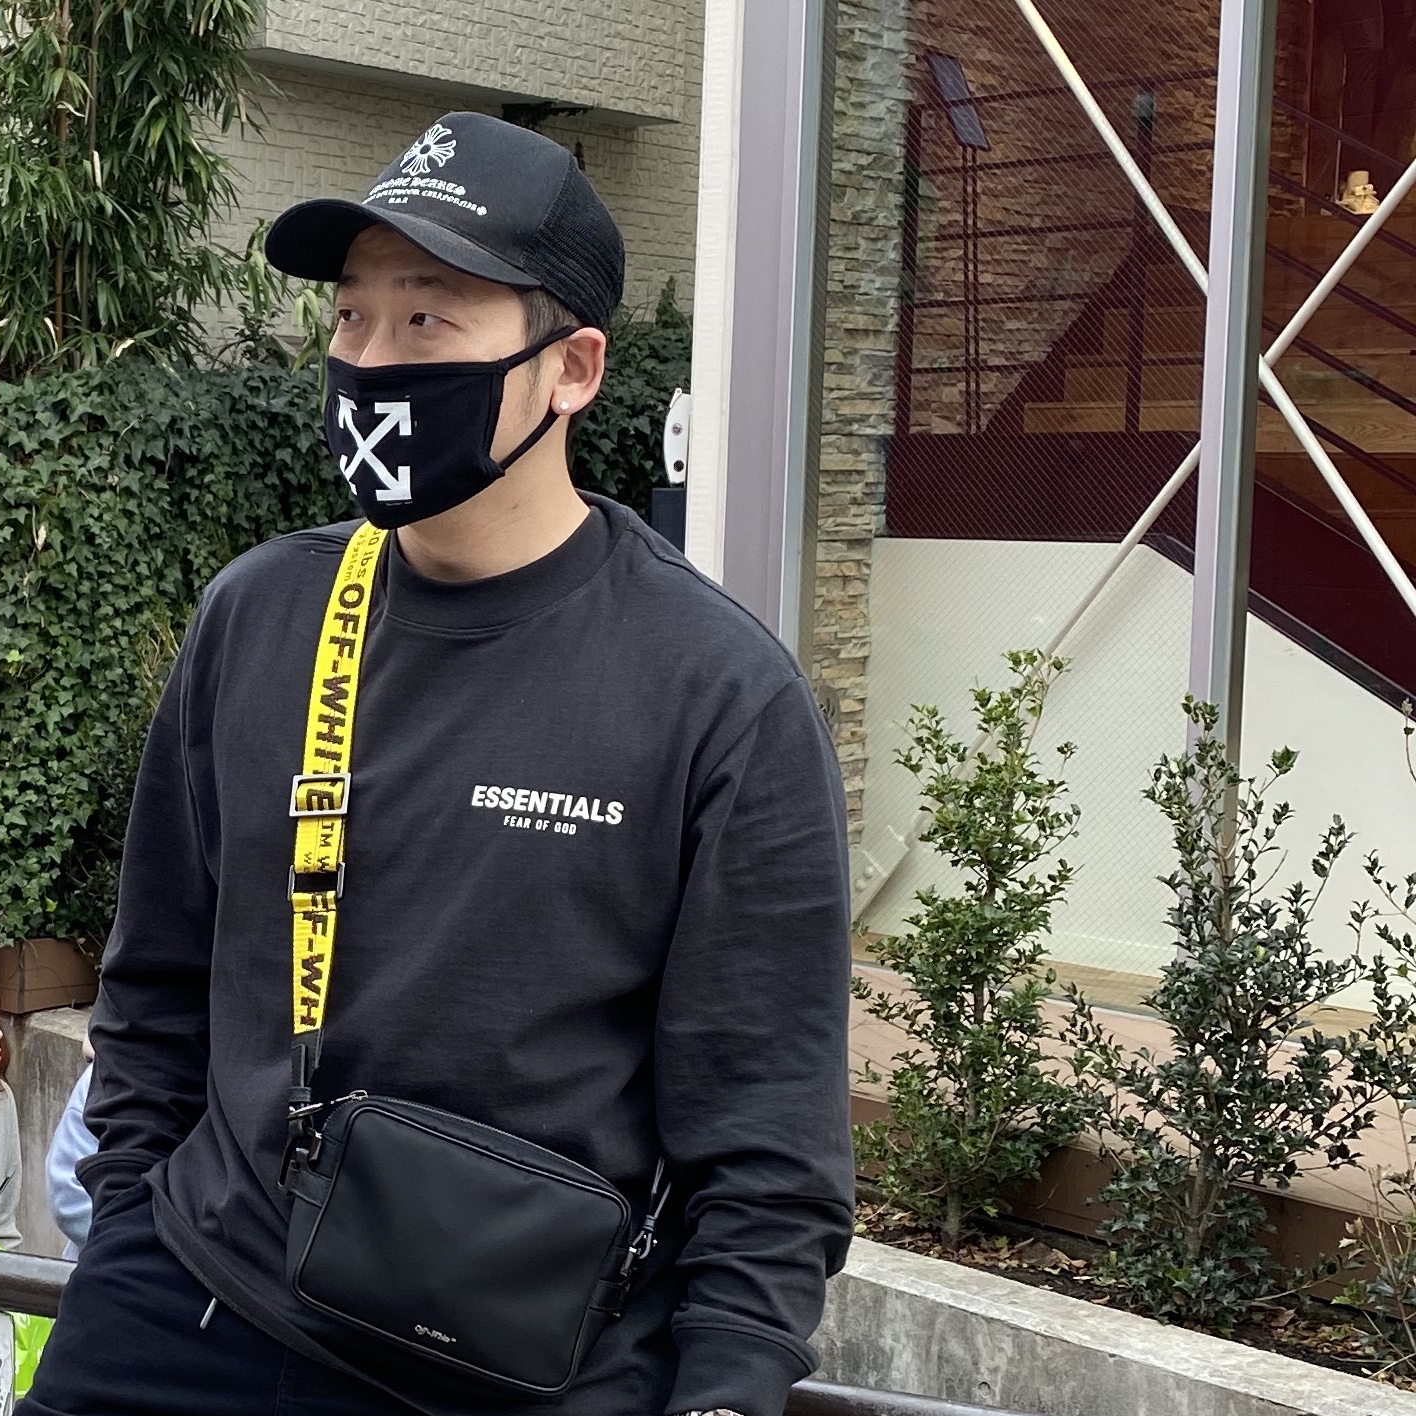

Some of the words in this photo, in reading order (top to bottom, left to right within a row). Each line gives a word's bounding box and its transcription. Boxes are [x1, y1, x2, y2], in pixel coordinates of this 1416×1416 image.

[471, 785, 624, 825] ESSENTIALS
[503, 815, 532, 829] FEAR
[535, 819, 550, 831] OF
[554, 822, 577, 835] GOD
